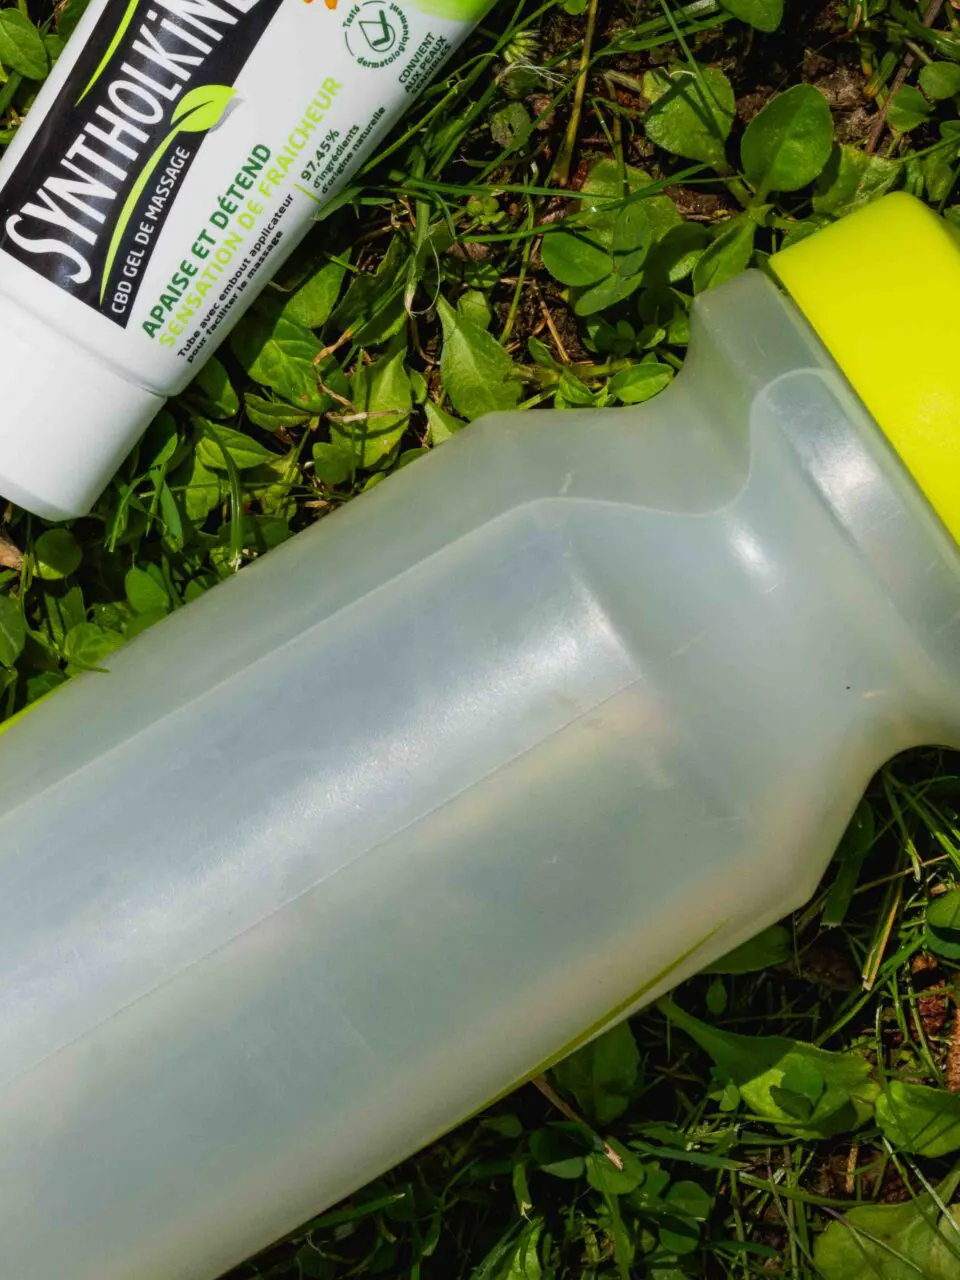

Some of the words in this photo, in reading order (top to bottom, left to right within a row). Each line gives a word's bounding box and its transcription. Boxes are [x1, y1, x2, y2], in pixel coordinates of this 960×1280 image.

[342, 4, 361, 28] Testé
[398, 31, 436, 84] CONVIENT
[404, 72, 422, 94] AUX
[419, 35, 448, 73] PEAUX
[300, 129, 340, 181] 97,45%
[313, 124, 360, 189] d'ingrédients
[352, 106, 386, 152] naturelle
[111, 280, 132, 314] CBD
[123, 245, 145, 278] GEL
[134, 222, 154, 246] DE
[146, 145, 190, 223] MASSAGE
[142, 259, 198, 339] APAISE
[191, 228, 217, 260] ET
[209, 143, 272, 230] DÉTEND
[159, 231, 244, 349] SENSATION
[236, 199, 265, 231] DE
[257, 76, 343, 200] FRAICHEUR
[177, 330, 201, 358] Tube
[200, 304, 220, 329] avec
[219, 258, 251, 302] embout
[249, 193, 294, 258] applicateur
[187, 337, 207, 364] pour
[206, 293, 239, 336] faciliter
[238, 280, 249, 292] le
[247, 230, 283, 280] massage
